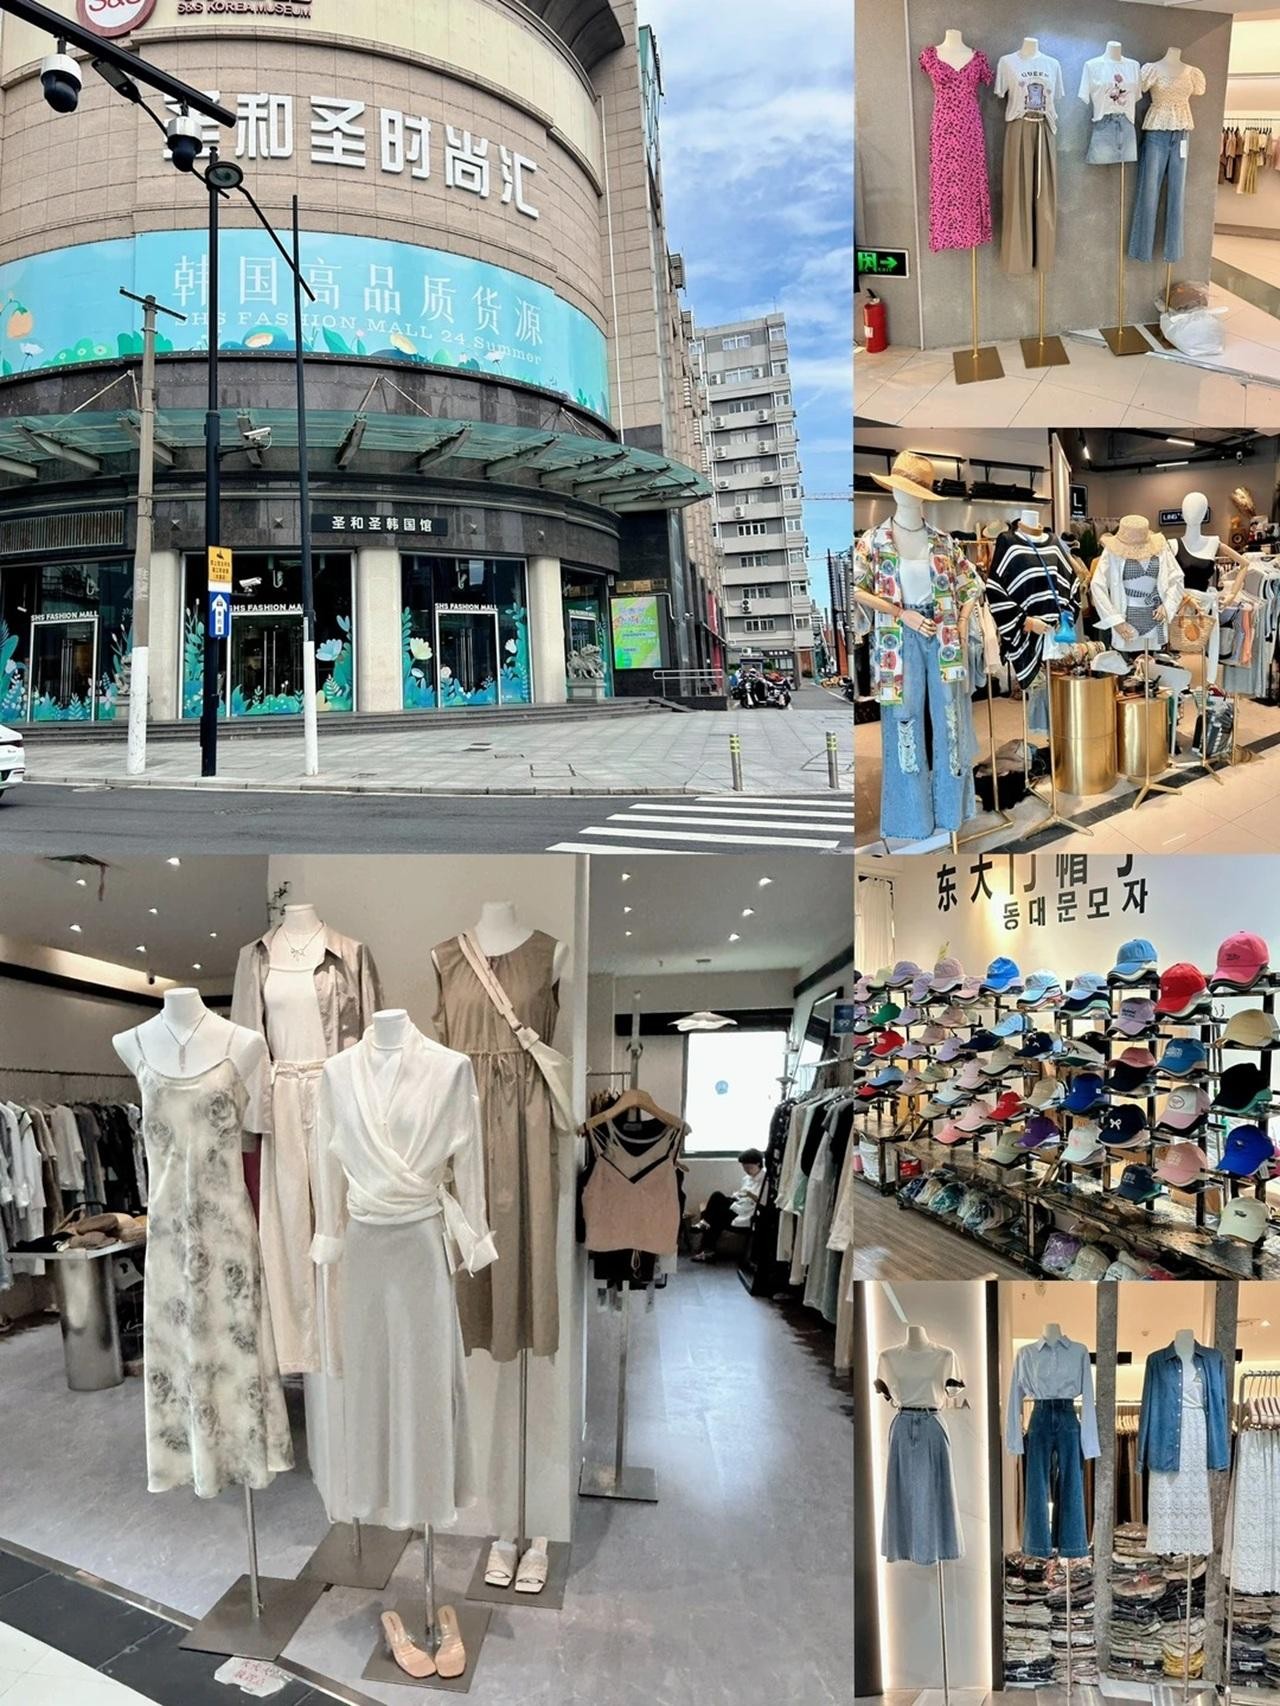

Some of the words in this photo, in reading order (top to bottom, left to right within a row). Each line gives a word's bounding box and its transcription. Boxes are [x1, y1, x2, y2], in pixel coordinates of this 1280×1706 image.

[177, 4, 203, 15] S&S
[207, 3, 254, 15] KOREA
[255, 3, 312, 19] MUSEUM
[171, 253, 544, 347] 韩国高品质货源
[367, 317, 433, 339] MALL
[441, 329, 465, 345] 24
[332, 516, 432, 532] 圣和圣韩国馆
[248, 604, 287, 612] FASHION
[450, 603, 480, 611] FASHION
[46, 612, 78, 621] FASHION
[79, 610, 99, 619] MALL
[1003, 878, 1148, 930] 동대문모자
